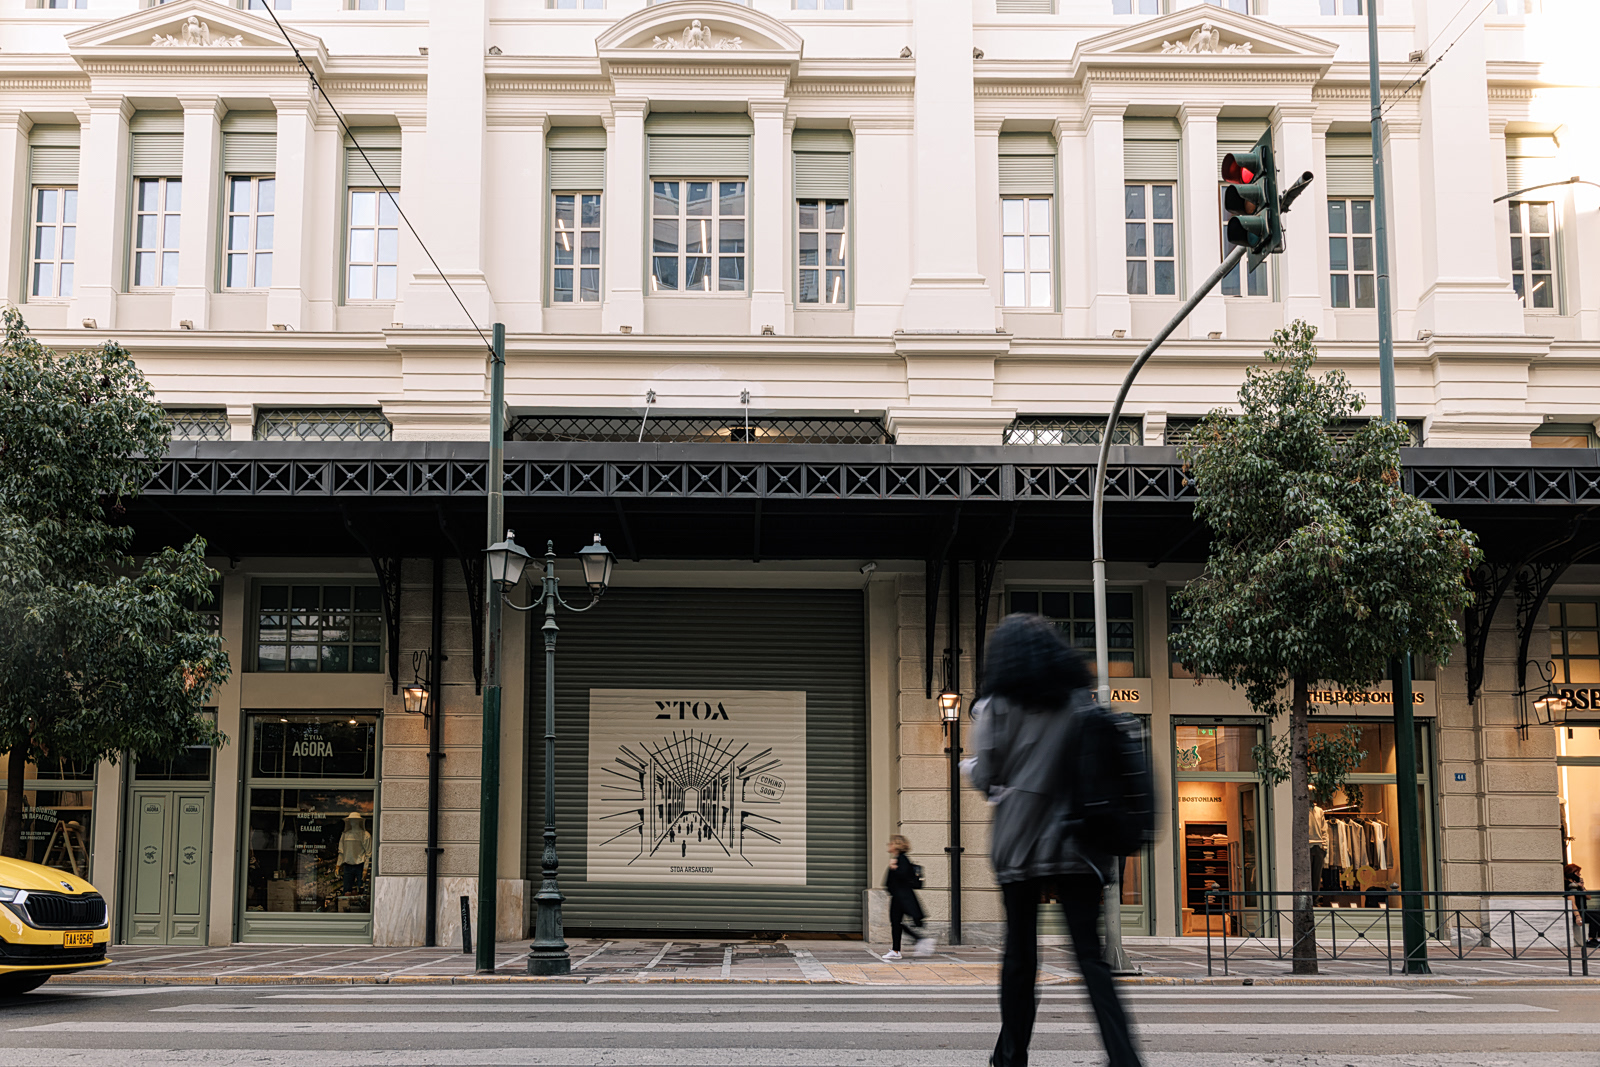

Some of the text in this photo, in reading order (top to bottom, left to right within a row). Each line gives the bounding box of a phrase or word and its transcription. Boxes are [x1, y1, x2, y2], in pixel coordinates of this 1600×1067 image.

[1306, 691, 1332, 702] THE
[292, 741, 333, 757] AGORA
[760, 776, 783, 788] COMING
[760, 786, 776, 797] SOON
